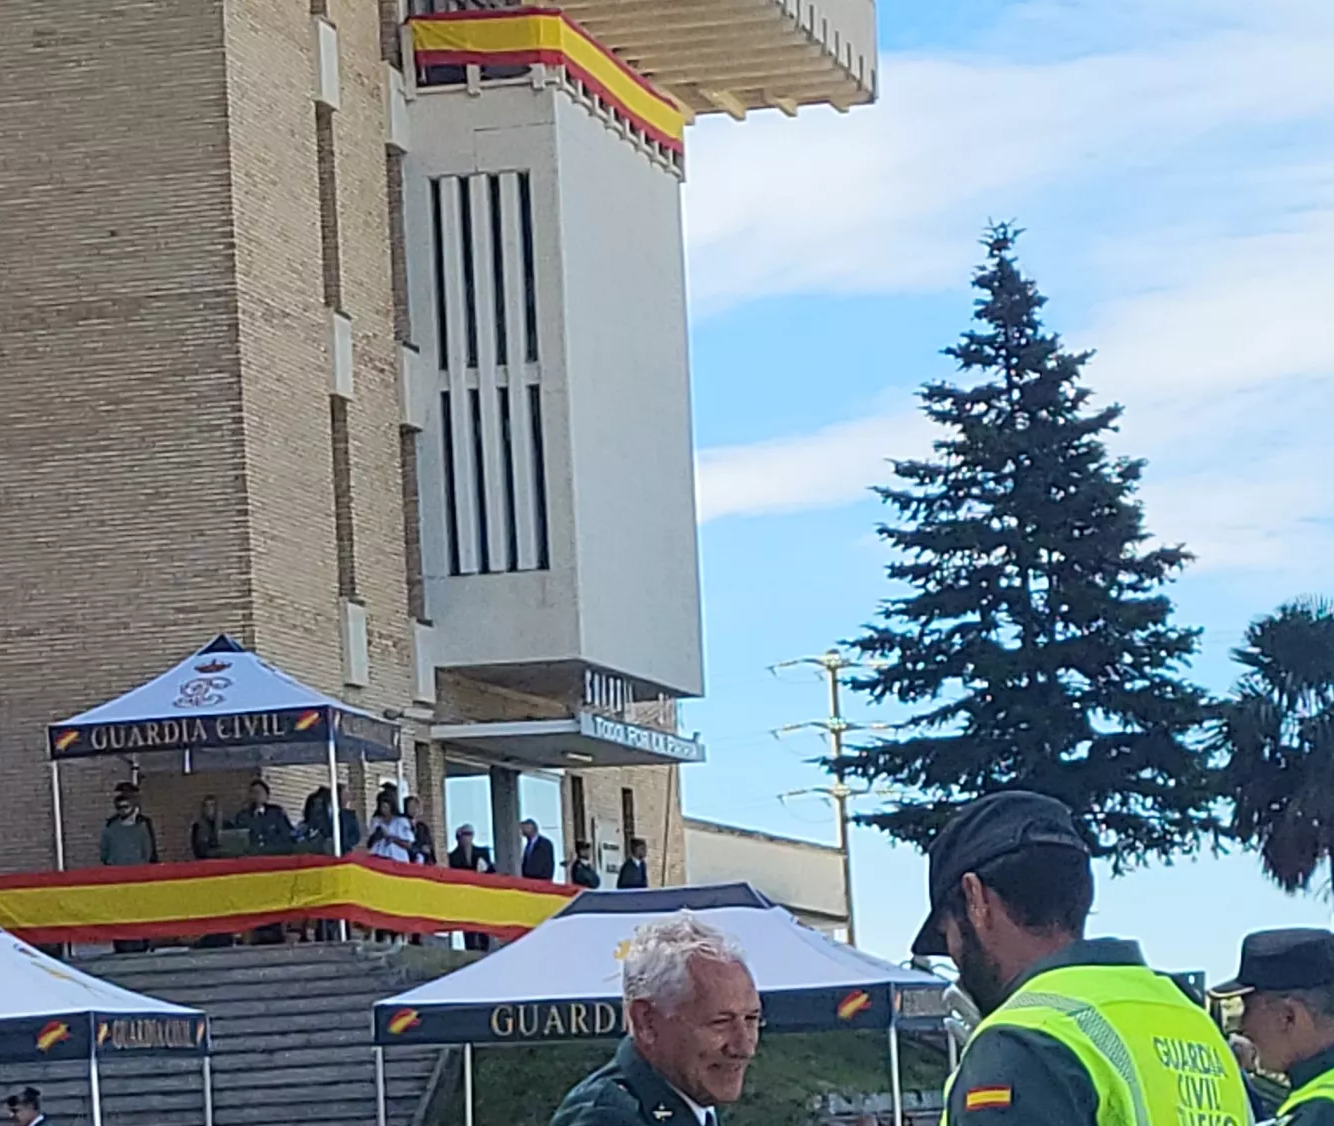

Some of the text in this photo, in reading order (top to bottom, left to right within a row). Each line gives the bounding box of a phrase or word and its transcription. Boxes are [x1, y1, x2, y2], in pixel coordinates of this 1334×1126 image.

[90, 712, 286, 751] GUARDIA CIVIL
[112, 1018, 166, 1050] GUARDIA
[1153, 1036, 1228, 1079] GUARDIA
[1178, 1073, 1221, 1111] CIVIL
